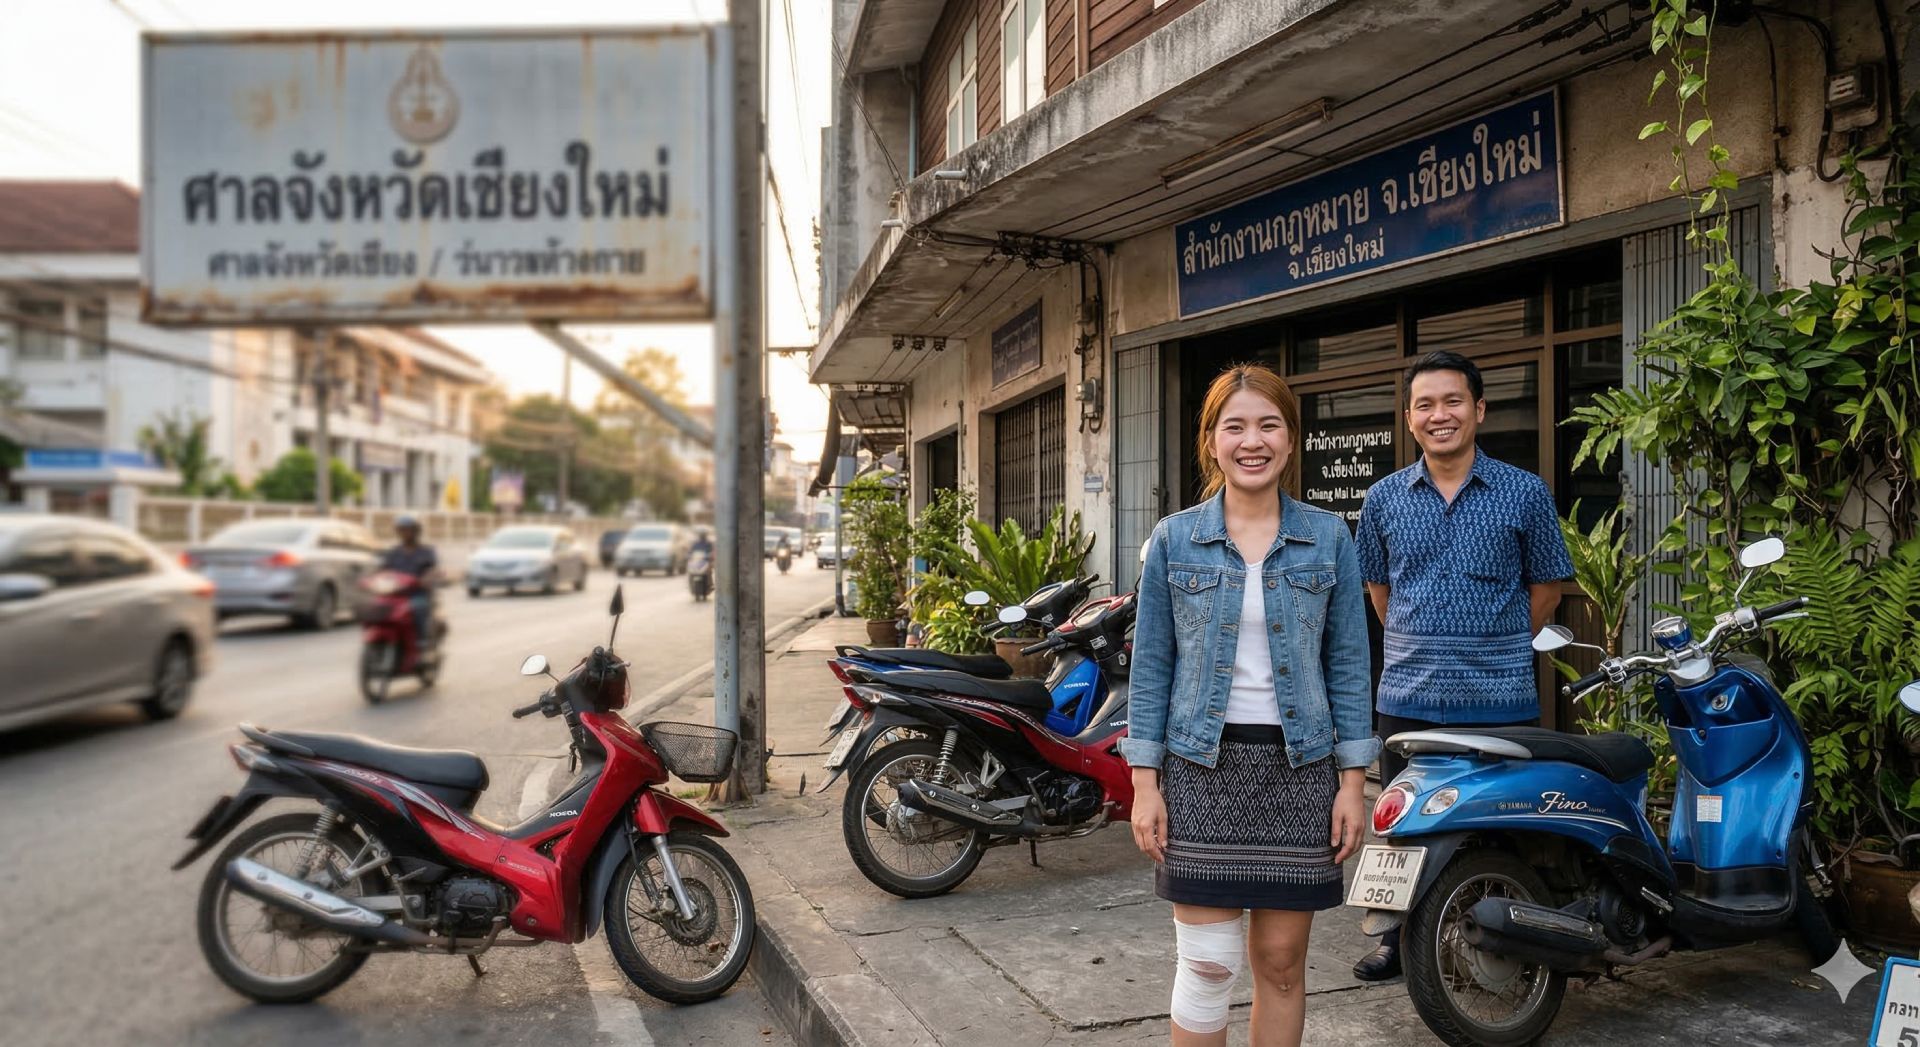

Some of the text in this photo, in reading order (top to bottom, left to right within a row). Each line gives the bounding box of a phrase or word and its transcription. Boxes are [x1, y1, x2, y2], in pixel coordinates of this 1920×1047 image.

[184, 143, 670, 223] ศาลจังหวัดเชียงใหม่
[1183, 111, 1543, 276] สำนักงานกฎหมาย จ.เชียงใหม่
[1287, 228, 1385, 280] จ.เชียงใหม่
[1305, 430, 1392, 453] สำนักงานกฎหมาย
[1307, 487, 1333, 502] Chiang
[1334, 487, 1349, 500] Mai
[1538, 791, 1588, 814] Fino
